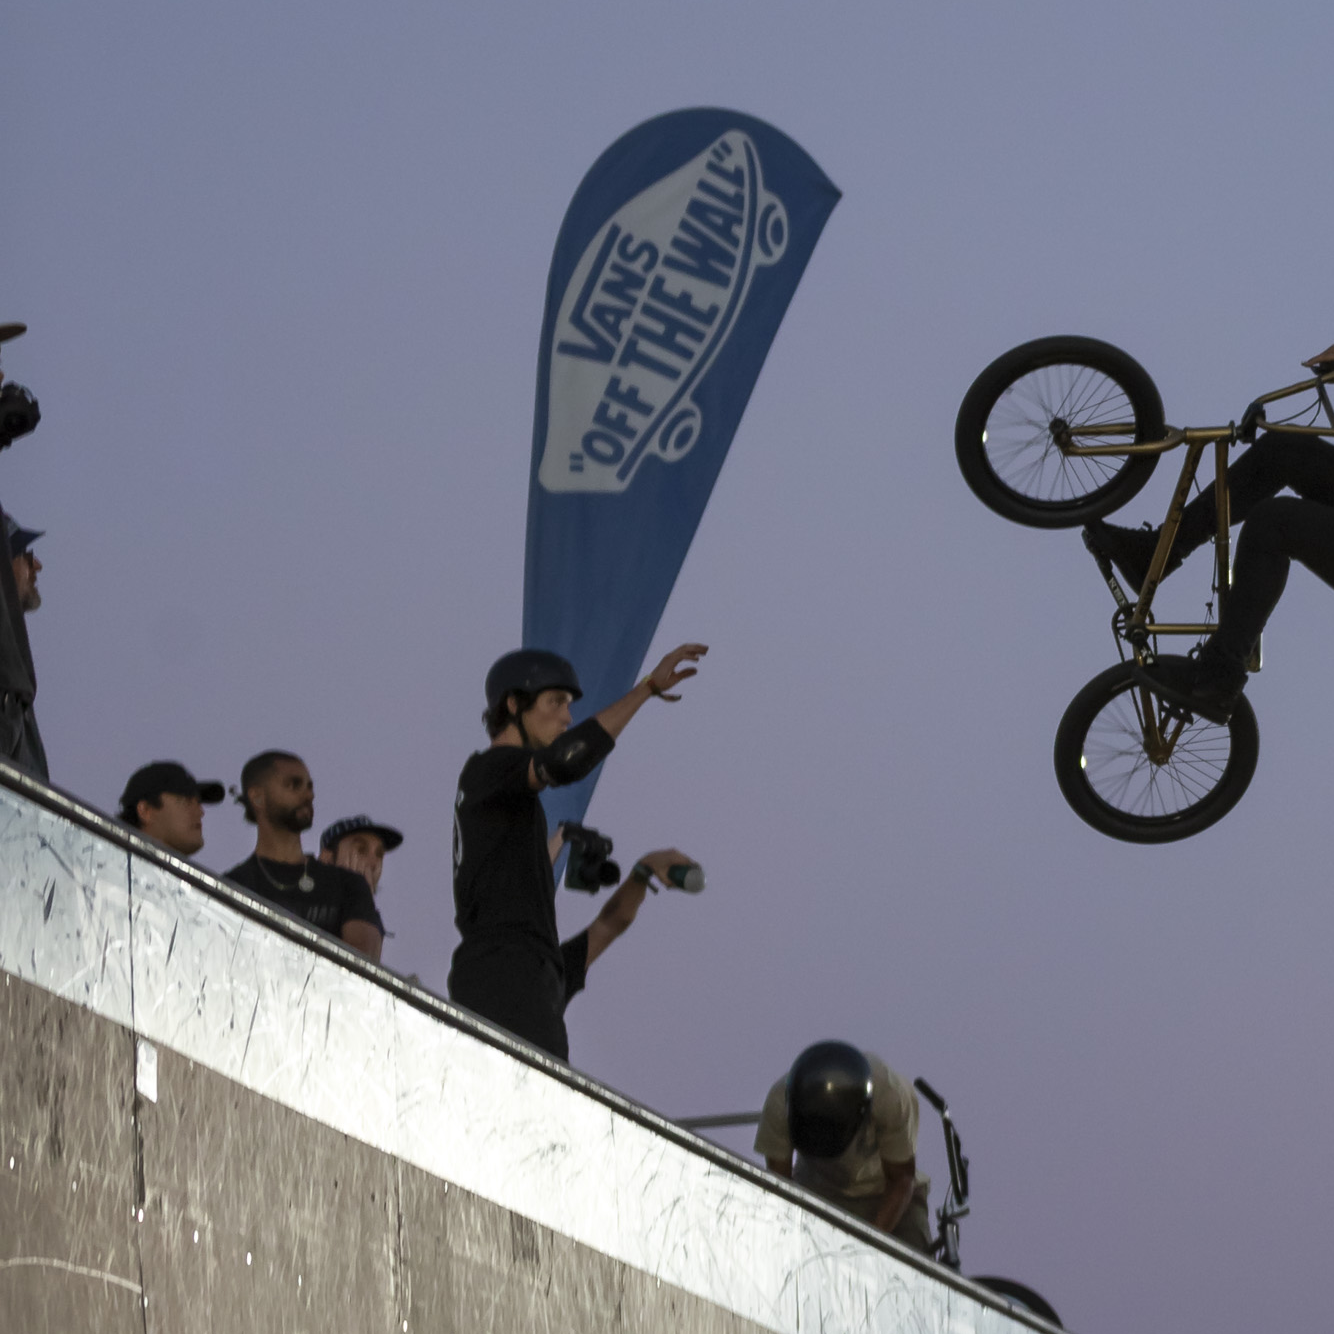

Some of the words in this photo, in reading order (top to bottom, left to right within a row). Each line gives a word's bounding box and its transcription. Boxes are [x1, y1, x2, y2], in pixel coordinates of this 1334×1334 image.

[660, 139, 746, 290] WALL"
[555, 222, 660, 365] VANS
[616, 273, 721, 383] THE
[568, 375, 656, 474] "OFF
